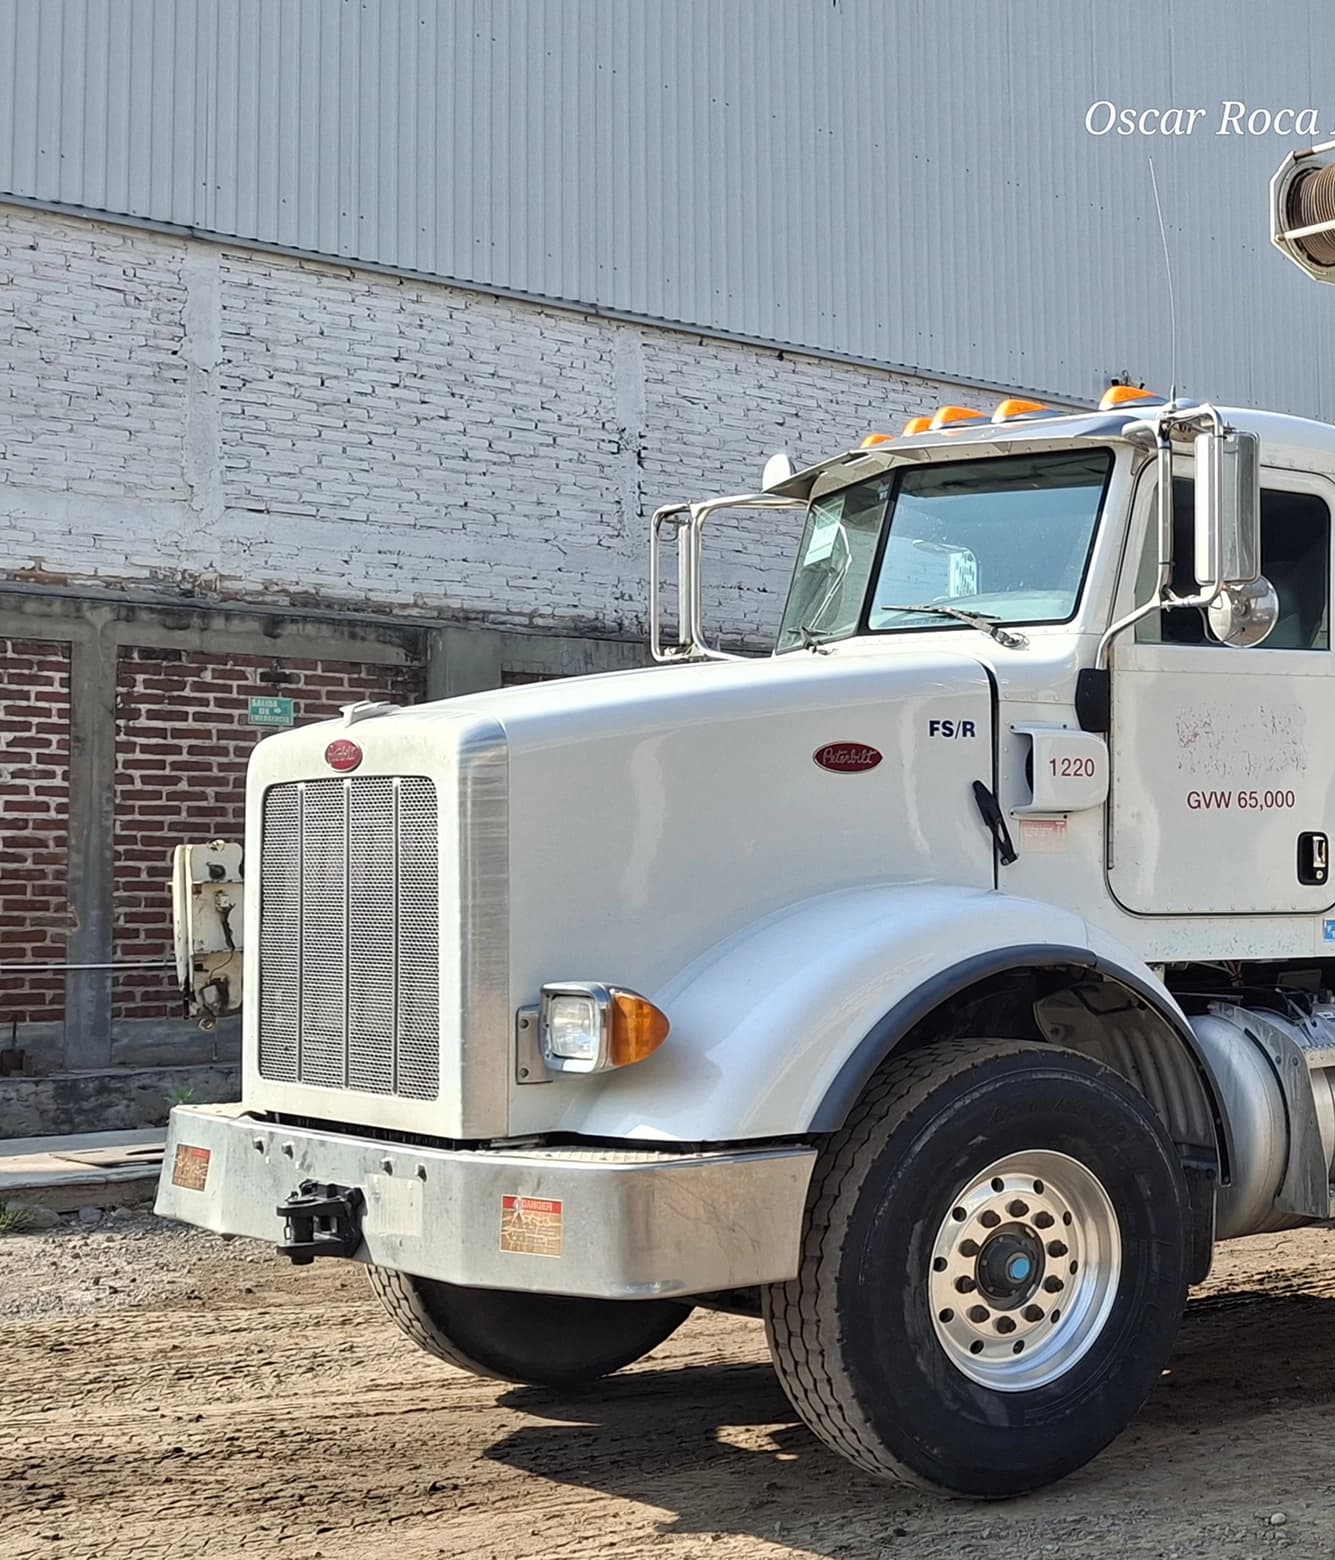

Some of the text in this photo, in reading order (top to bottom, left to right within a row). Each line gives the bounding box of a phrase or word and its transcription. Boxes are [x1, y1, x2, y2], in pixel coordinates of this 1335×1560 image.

[928, 719, 976, 740] FS/R
[822, 747, 878, 765] Peterbilt
[1049, 757, 1095, 777] 1220
[1187, 790, 1296, 811] GVW 65,000
